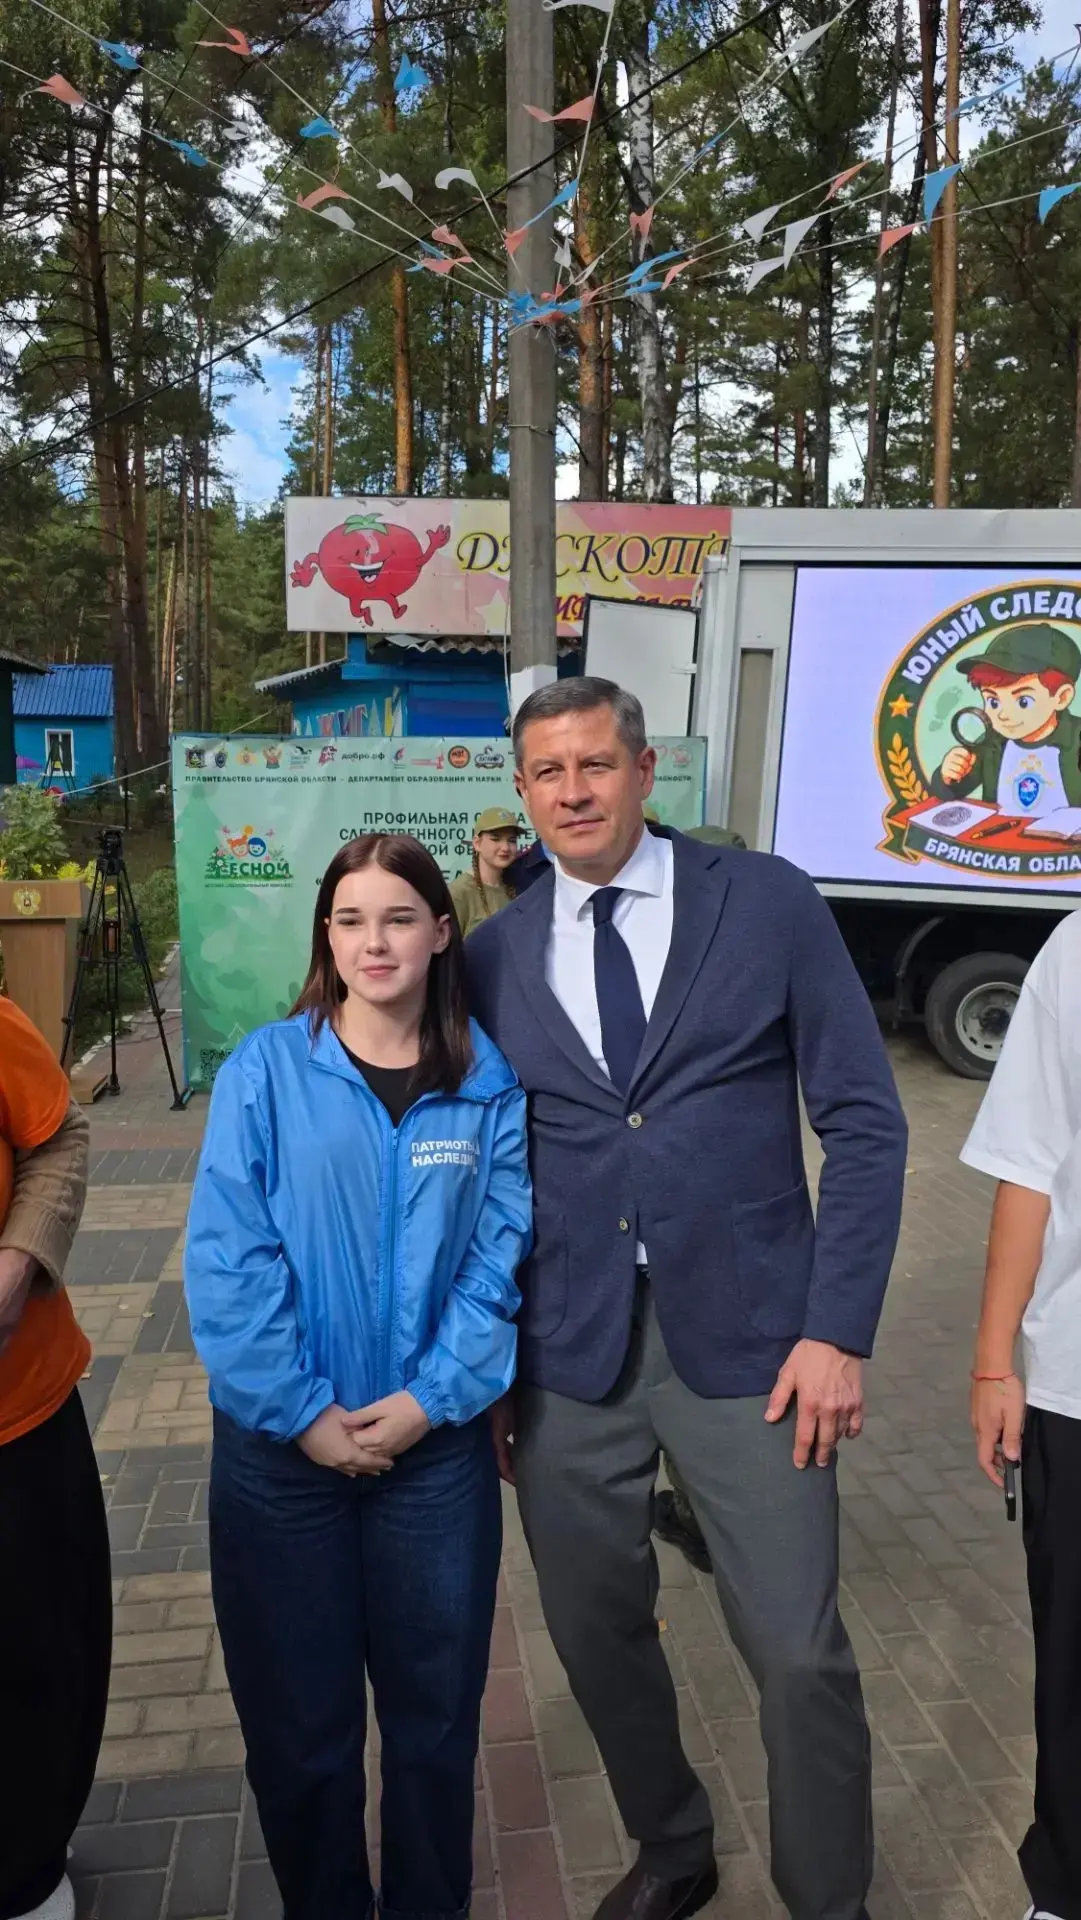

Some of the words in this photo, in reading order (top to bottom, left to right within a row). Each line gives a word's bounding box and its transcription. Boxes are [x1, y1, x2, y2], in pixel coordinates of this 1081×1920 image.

[901, 604, 986, 685] ЮНЫЙ
[989, 590, 1081, 620] СЛЕД
[185, 775, 252, 783] ПРАВИТЕЛЬСТВО
[255, 775, 299, 783] БРЯНСКОЙ
[301, 775, 337, 783] ОБЛАСТИ
[347, 775, 405, 783] ДЕПАРТАМЕНТ
[407, 775, 466, 783] ОБРАЗОВАНИЯ
[467, 775, 474, 783] И
[475, 775, 502, 783] НАУКИ
[363, 812, 469, 825] ПРОФИЛЬНАЯ
[923, 837, 1021, 873] БРЯНСКАЯ
